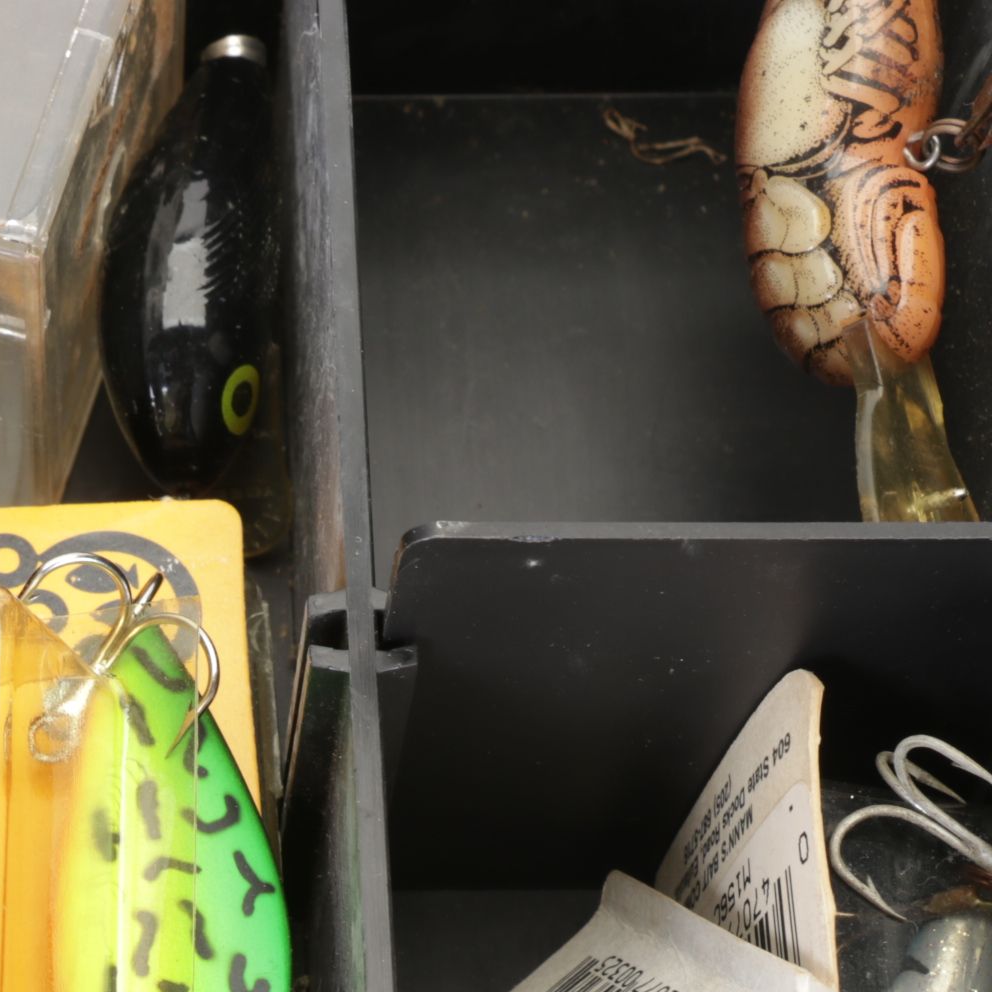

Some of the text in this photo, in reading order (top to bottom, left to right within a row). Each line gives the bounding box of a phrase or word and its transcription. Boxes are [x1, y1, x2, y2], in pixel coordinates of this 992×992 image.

[772, 732, 791, 767] 604
[748, 756, 769, 792] State
[722, 787, 746, 829] Docks
[721, 803, 753, 864] MANN'S
[702, 856, 719, 893] BAIT
